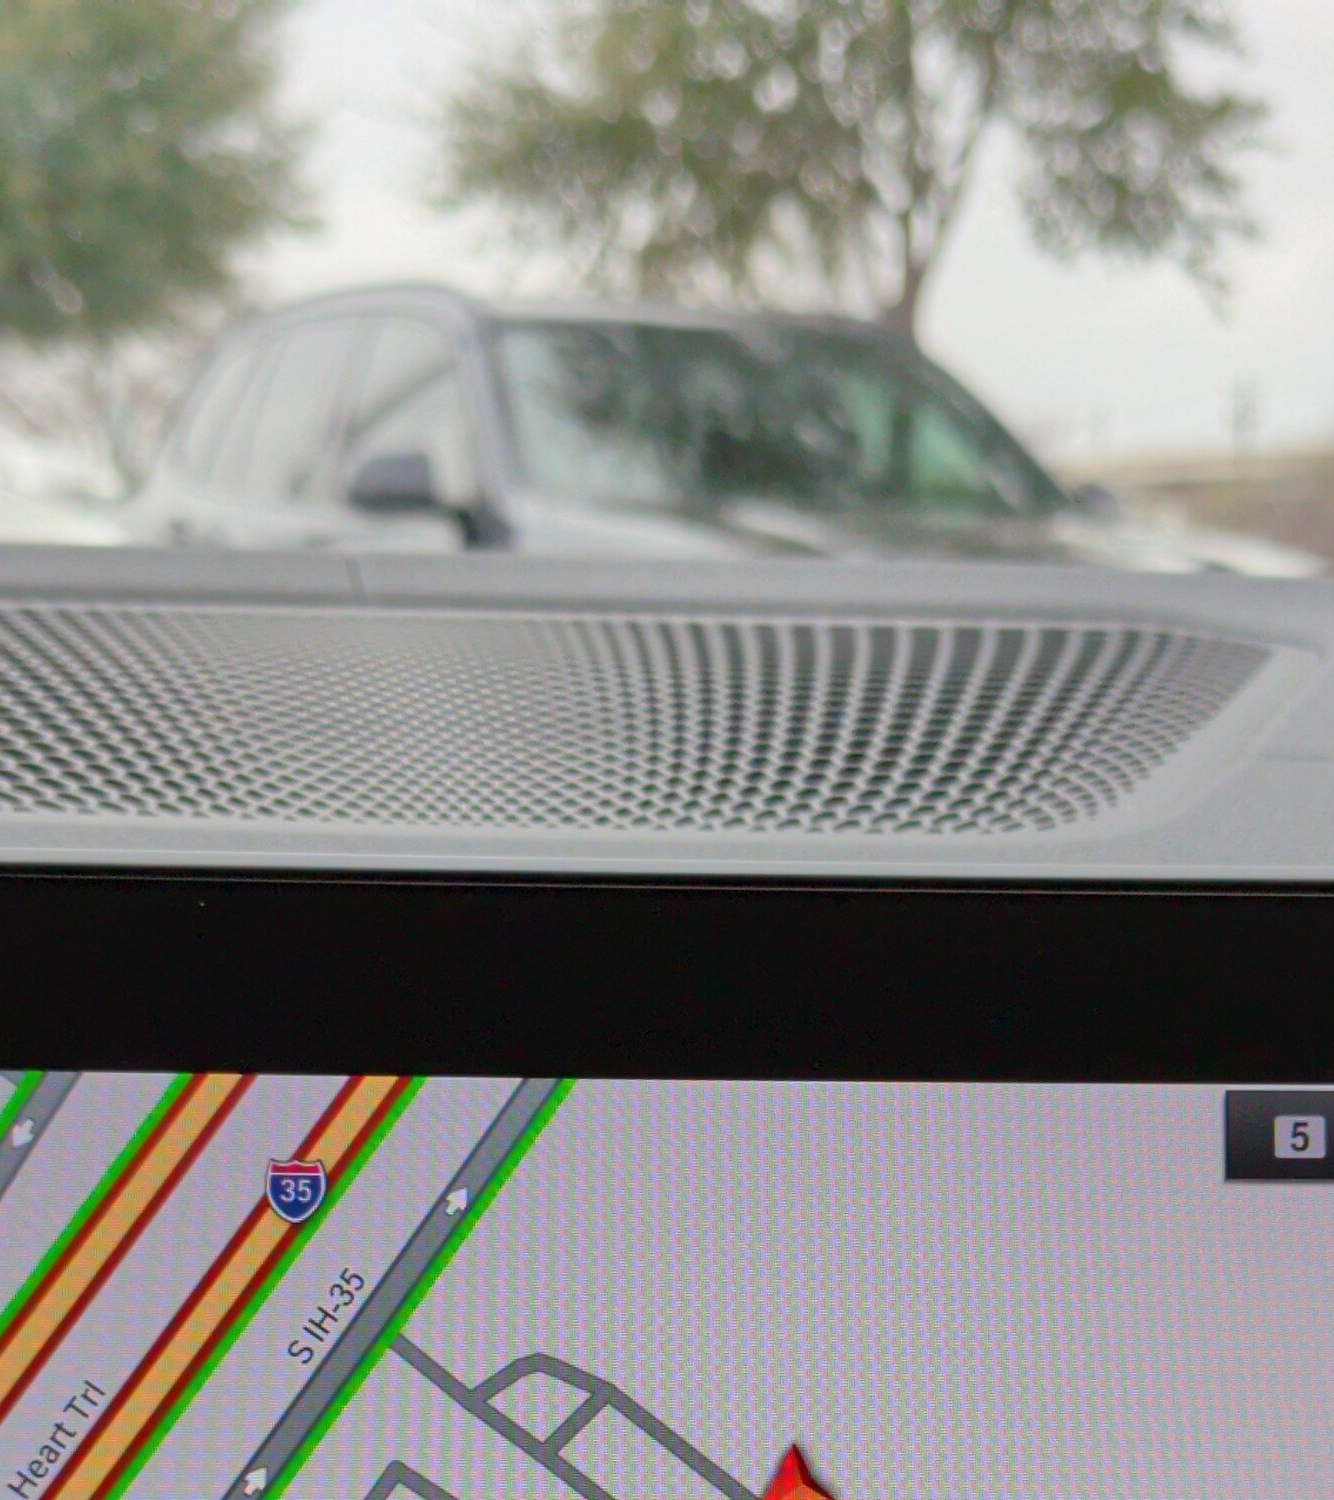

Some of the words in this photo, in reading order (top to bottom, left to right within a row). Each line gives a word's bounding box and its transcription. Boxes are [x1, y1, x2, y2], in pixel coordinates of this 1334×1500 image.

[1289, 1121, 1310, 1152] 5
[279, 1178, 312, 1204] 35
[287, 1339, 314, 1365] S
[302, 1266, 365, 1343] IH-35
[6, 1421, 78, 1500] Heart
[62, 1379, 107, 1419] Trl
